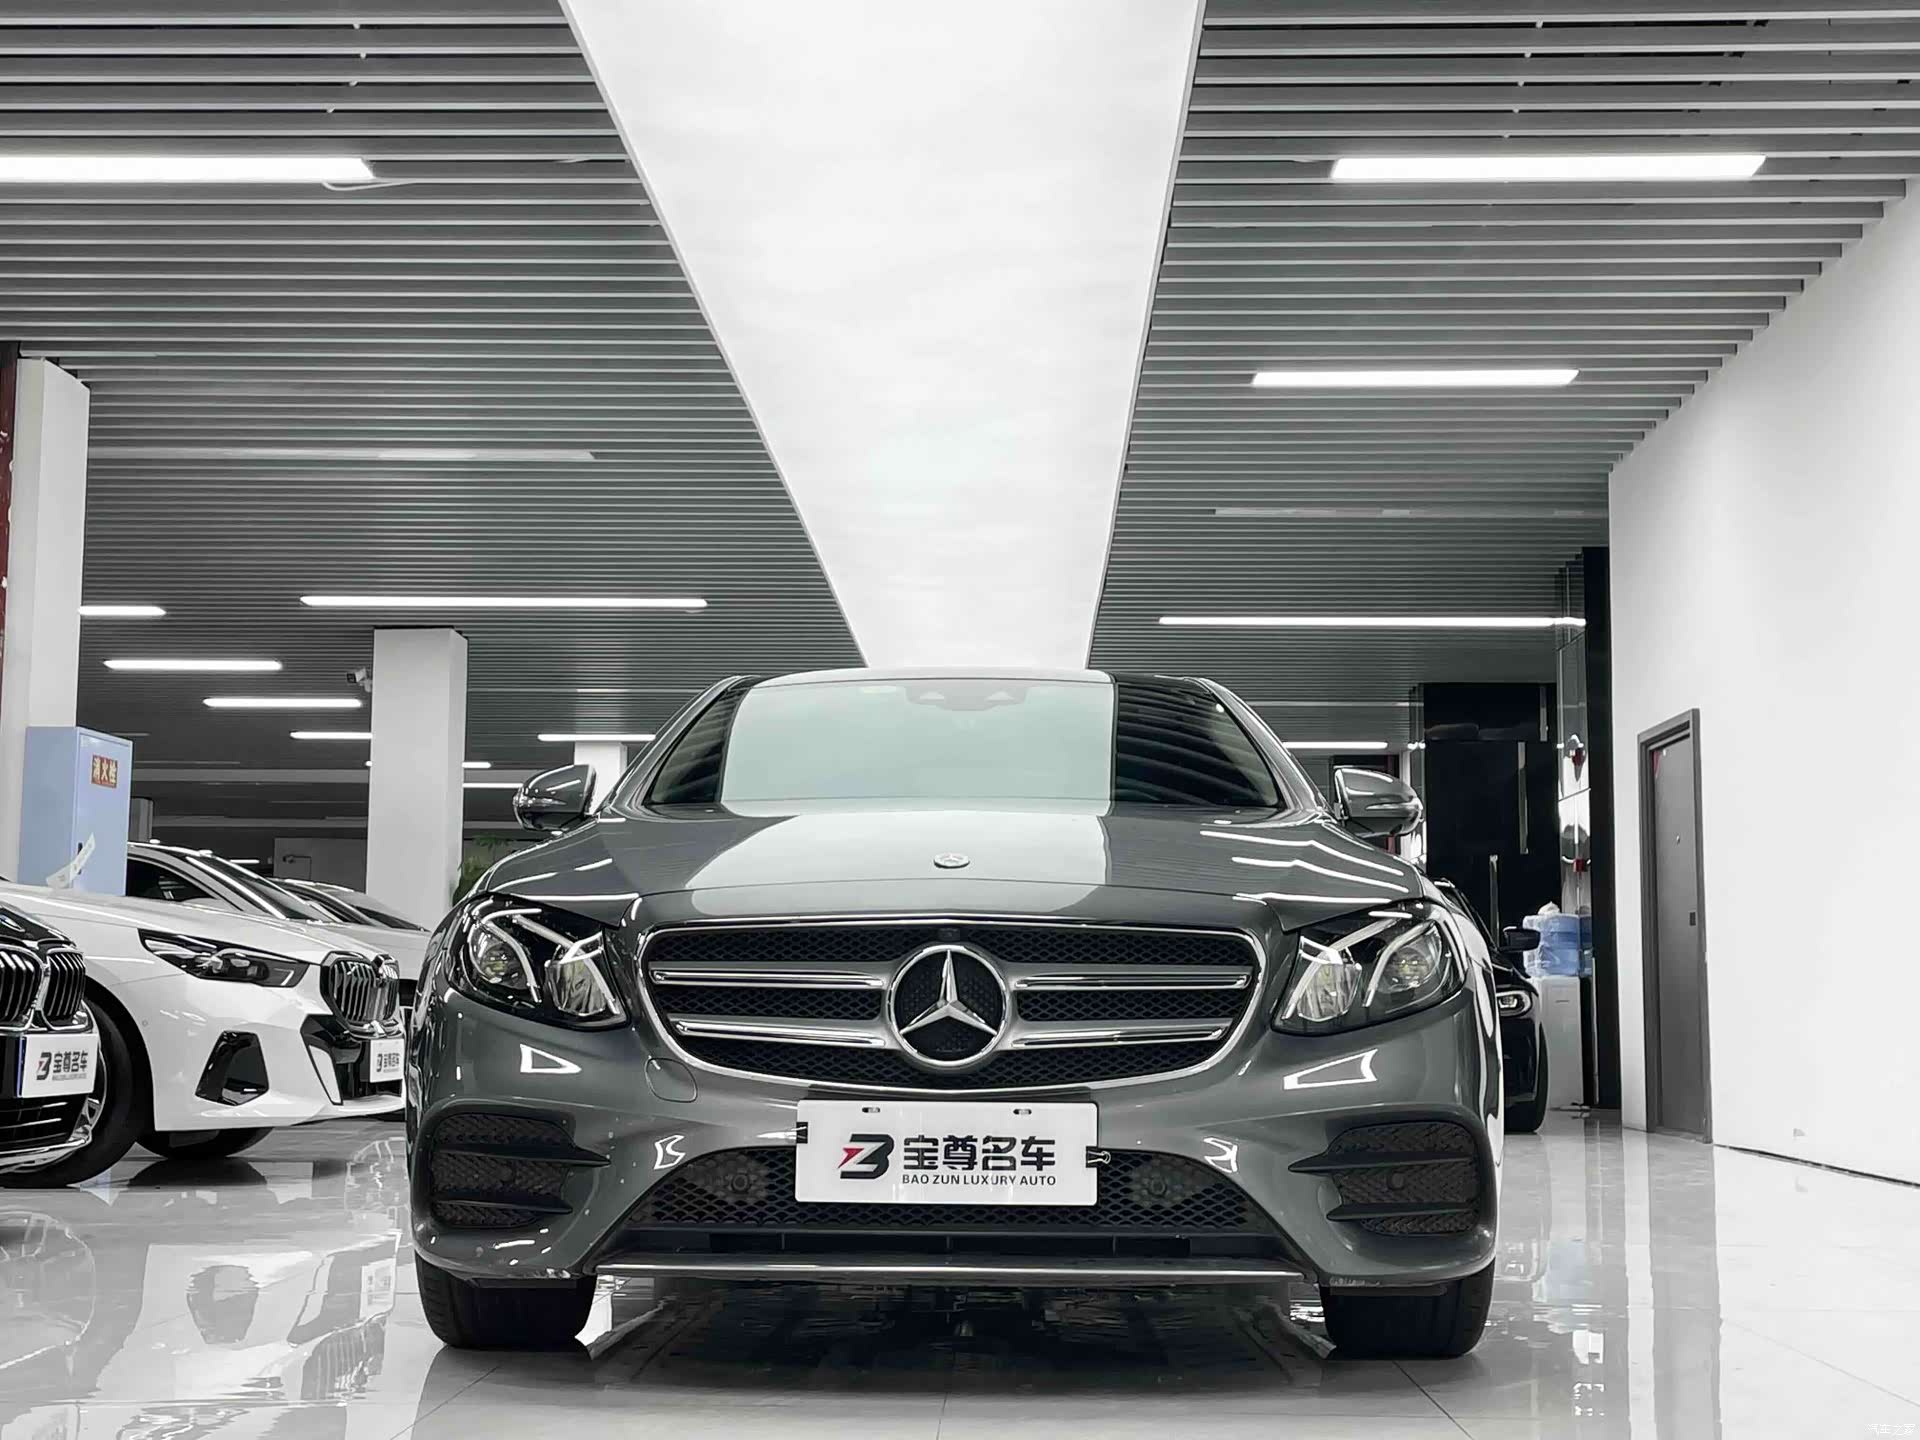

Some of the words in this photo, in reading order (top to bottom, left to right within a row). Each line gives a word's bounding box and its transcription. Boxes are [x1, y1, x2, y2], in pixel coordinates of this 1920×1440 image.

[903, 1134, 1056, 1172] 宝尊名车
[902, 1174, 930, 1185] BAO
[932, 1174, 960, 1185] ZUN
[963, 1174, 1017, 1186] LUXURY
[1019, 1175, 1057, 1186] AUTO
